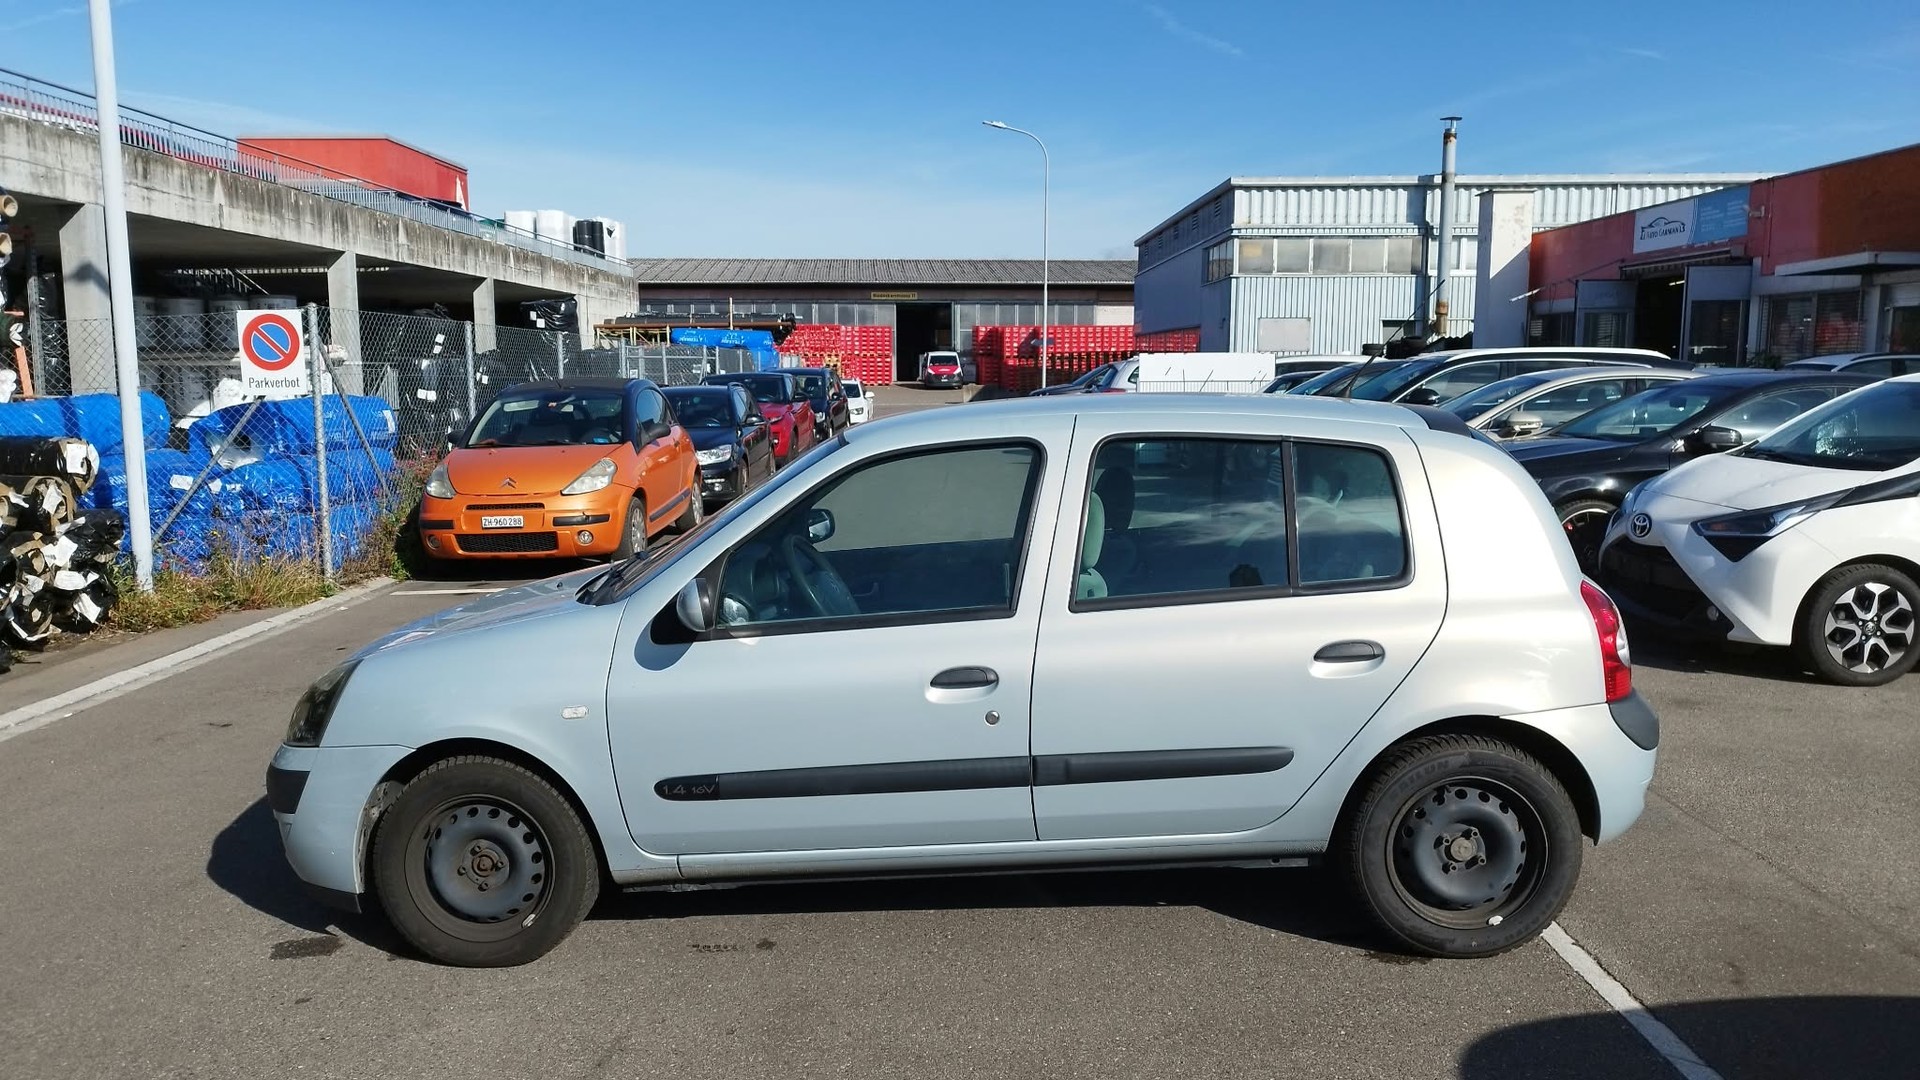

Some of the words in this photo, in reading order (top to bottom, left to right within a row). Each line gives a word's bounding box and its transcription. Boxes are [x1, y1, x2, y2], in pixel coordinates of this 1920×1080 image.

[248, 376, 300, 388] Parkverbot
[663, 784, 687, 795] 1.4
[692, 784, 715, 794] 16V
